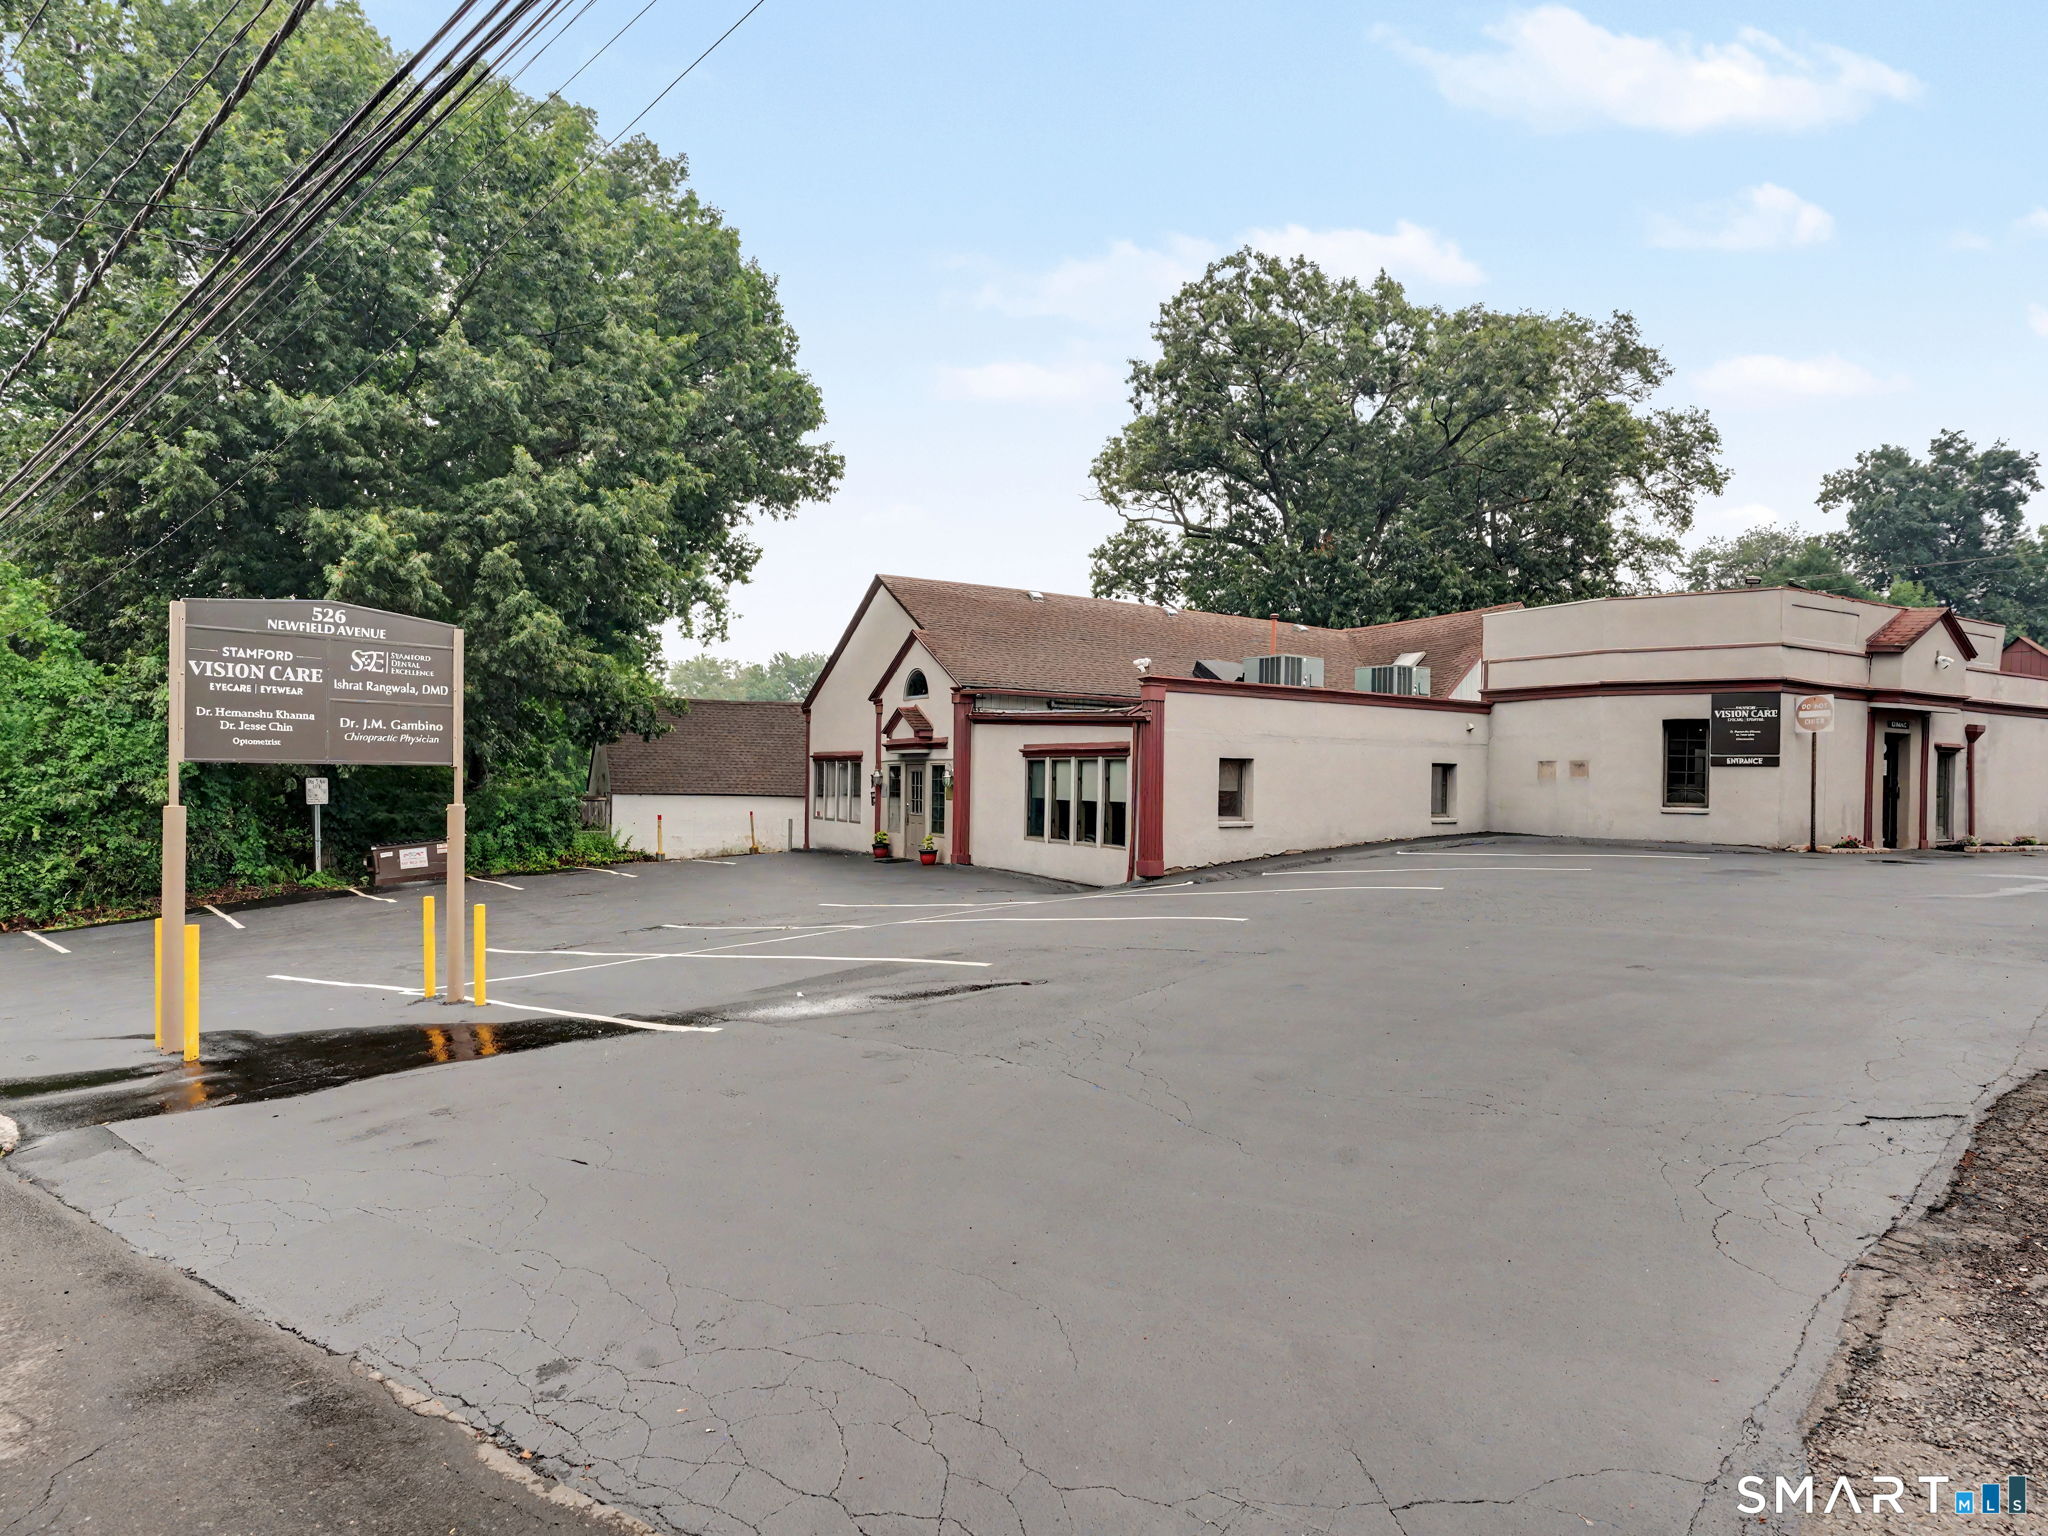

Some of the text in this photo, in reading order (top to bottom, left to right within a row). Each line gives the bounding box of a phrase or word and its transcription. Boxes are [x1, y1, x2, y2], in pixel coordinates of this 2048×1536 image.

[312, 607, 346, 623] 526
[267, 619, 386, 639] NEWFIELD AVENUE
[222, 646, 293, 661] STAMFORD
[390, 652, 431, 662] STAMFORD
[390, 659, 420, 669] DENTAL
[188, 660, 323, 683] VISION CARE
[390, 667, 435, 677] EXCELLENCE
[209, 683, 303, 696] EYECARE EYEWEAR
[333, 679, 449, 696] Ishrat Rangwala, DMD
[1814, 702, 1828, 710] NOT
[196, 707, 315, 721] Dr. Hemanshu Khanna
[1714, 709, 1778, 718] VISION CARE
[220, 720, 293, 732] Dr. Jesse Chin
[340, 717, 443, 732] Dr. J.M. Gambino
[232, 737, 281, 746] Optometrist
[344, 732, 440, 744] Chiropractic Physician
